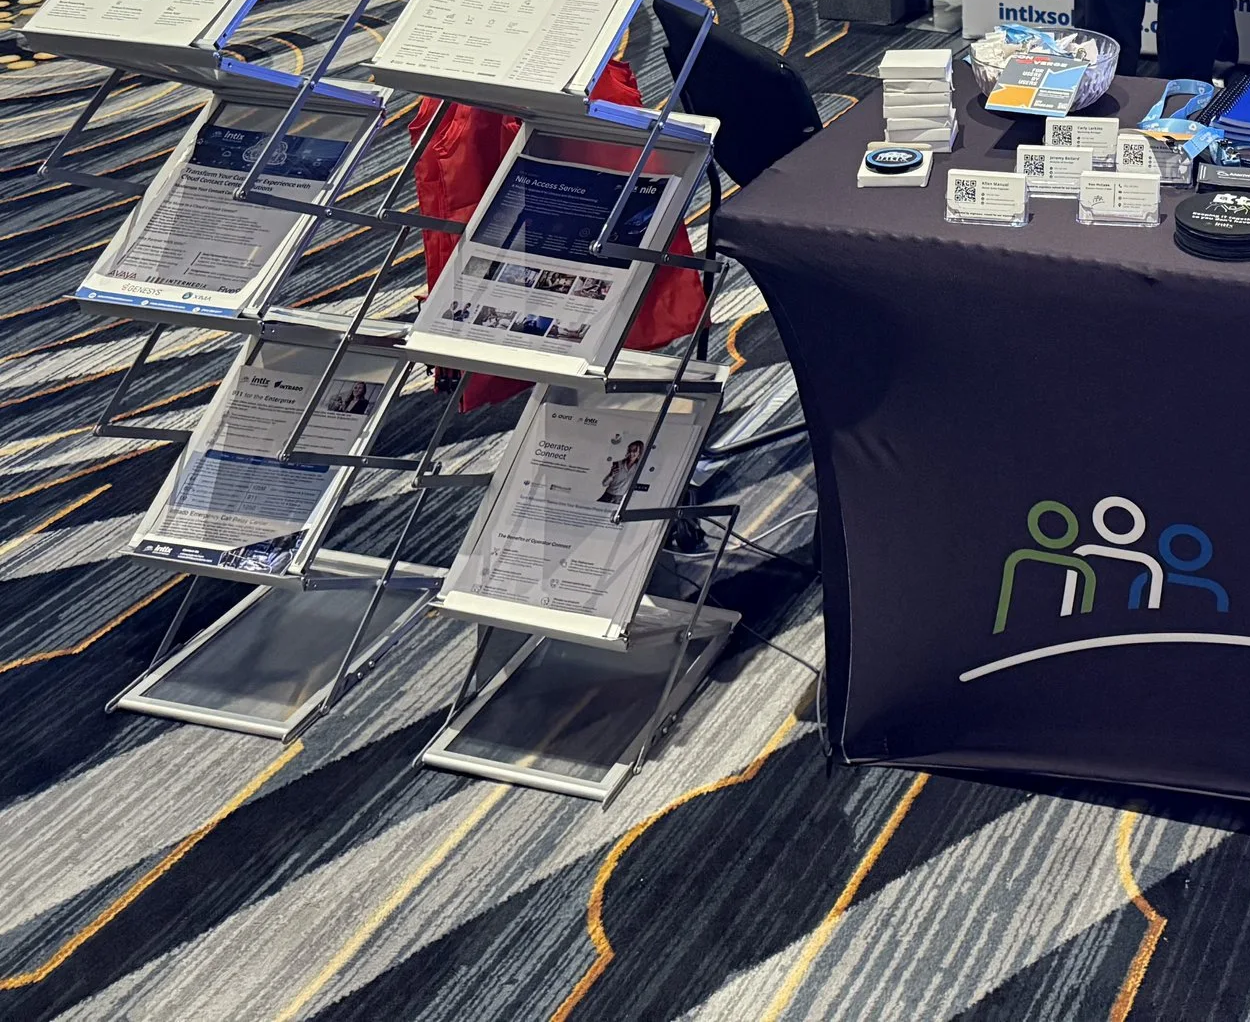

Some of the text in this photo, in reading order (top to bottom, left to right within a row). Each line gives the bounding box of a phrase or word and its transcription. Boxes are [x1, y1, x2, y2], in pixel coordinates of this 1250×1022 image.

[181, 174, 242, 188] Cloud Contact Cente
[185, 167, 311, 190] Transform Your Experience with
[515, 175, 586, 196] Nile Access Service
[639, 185, 657, 195] nile
[108, 269, 138, 280] AVAYA
[264, 394, 296, 405] Enterprise
[539, 440, 574, 452] Operator
[535, 448, 567, 460] Connect
